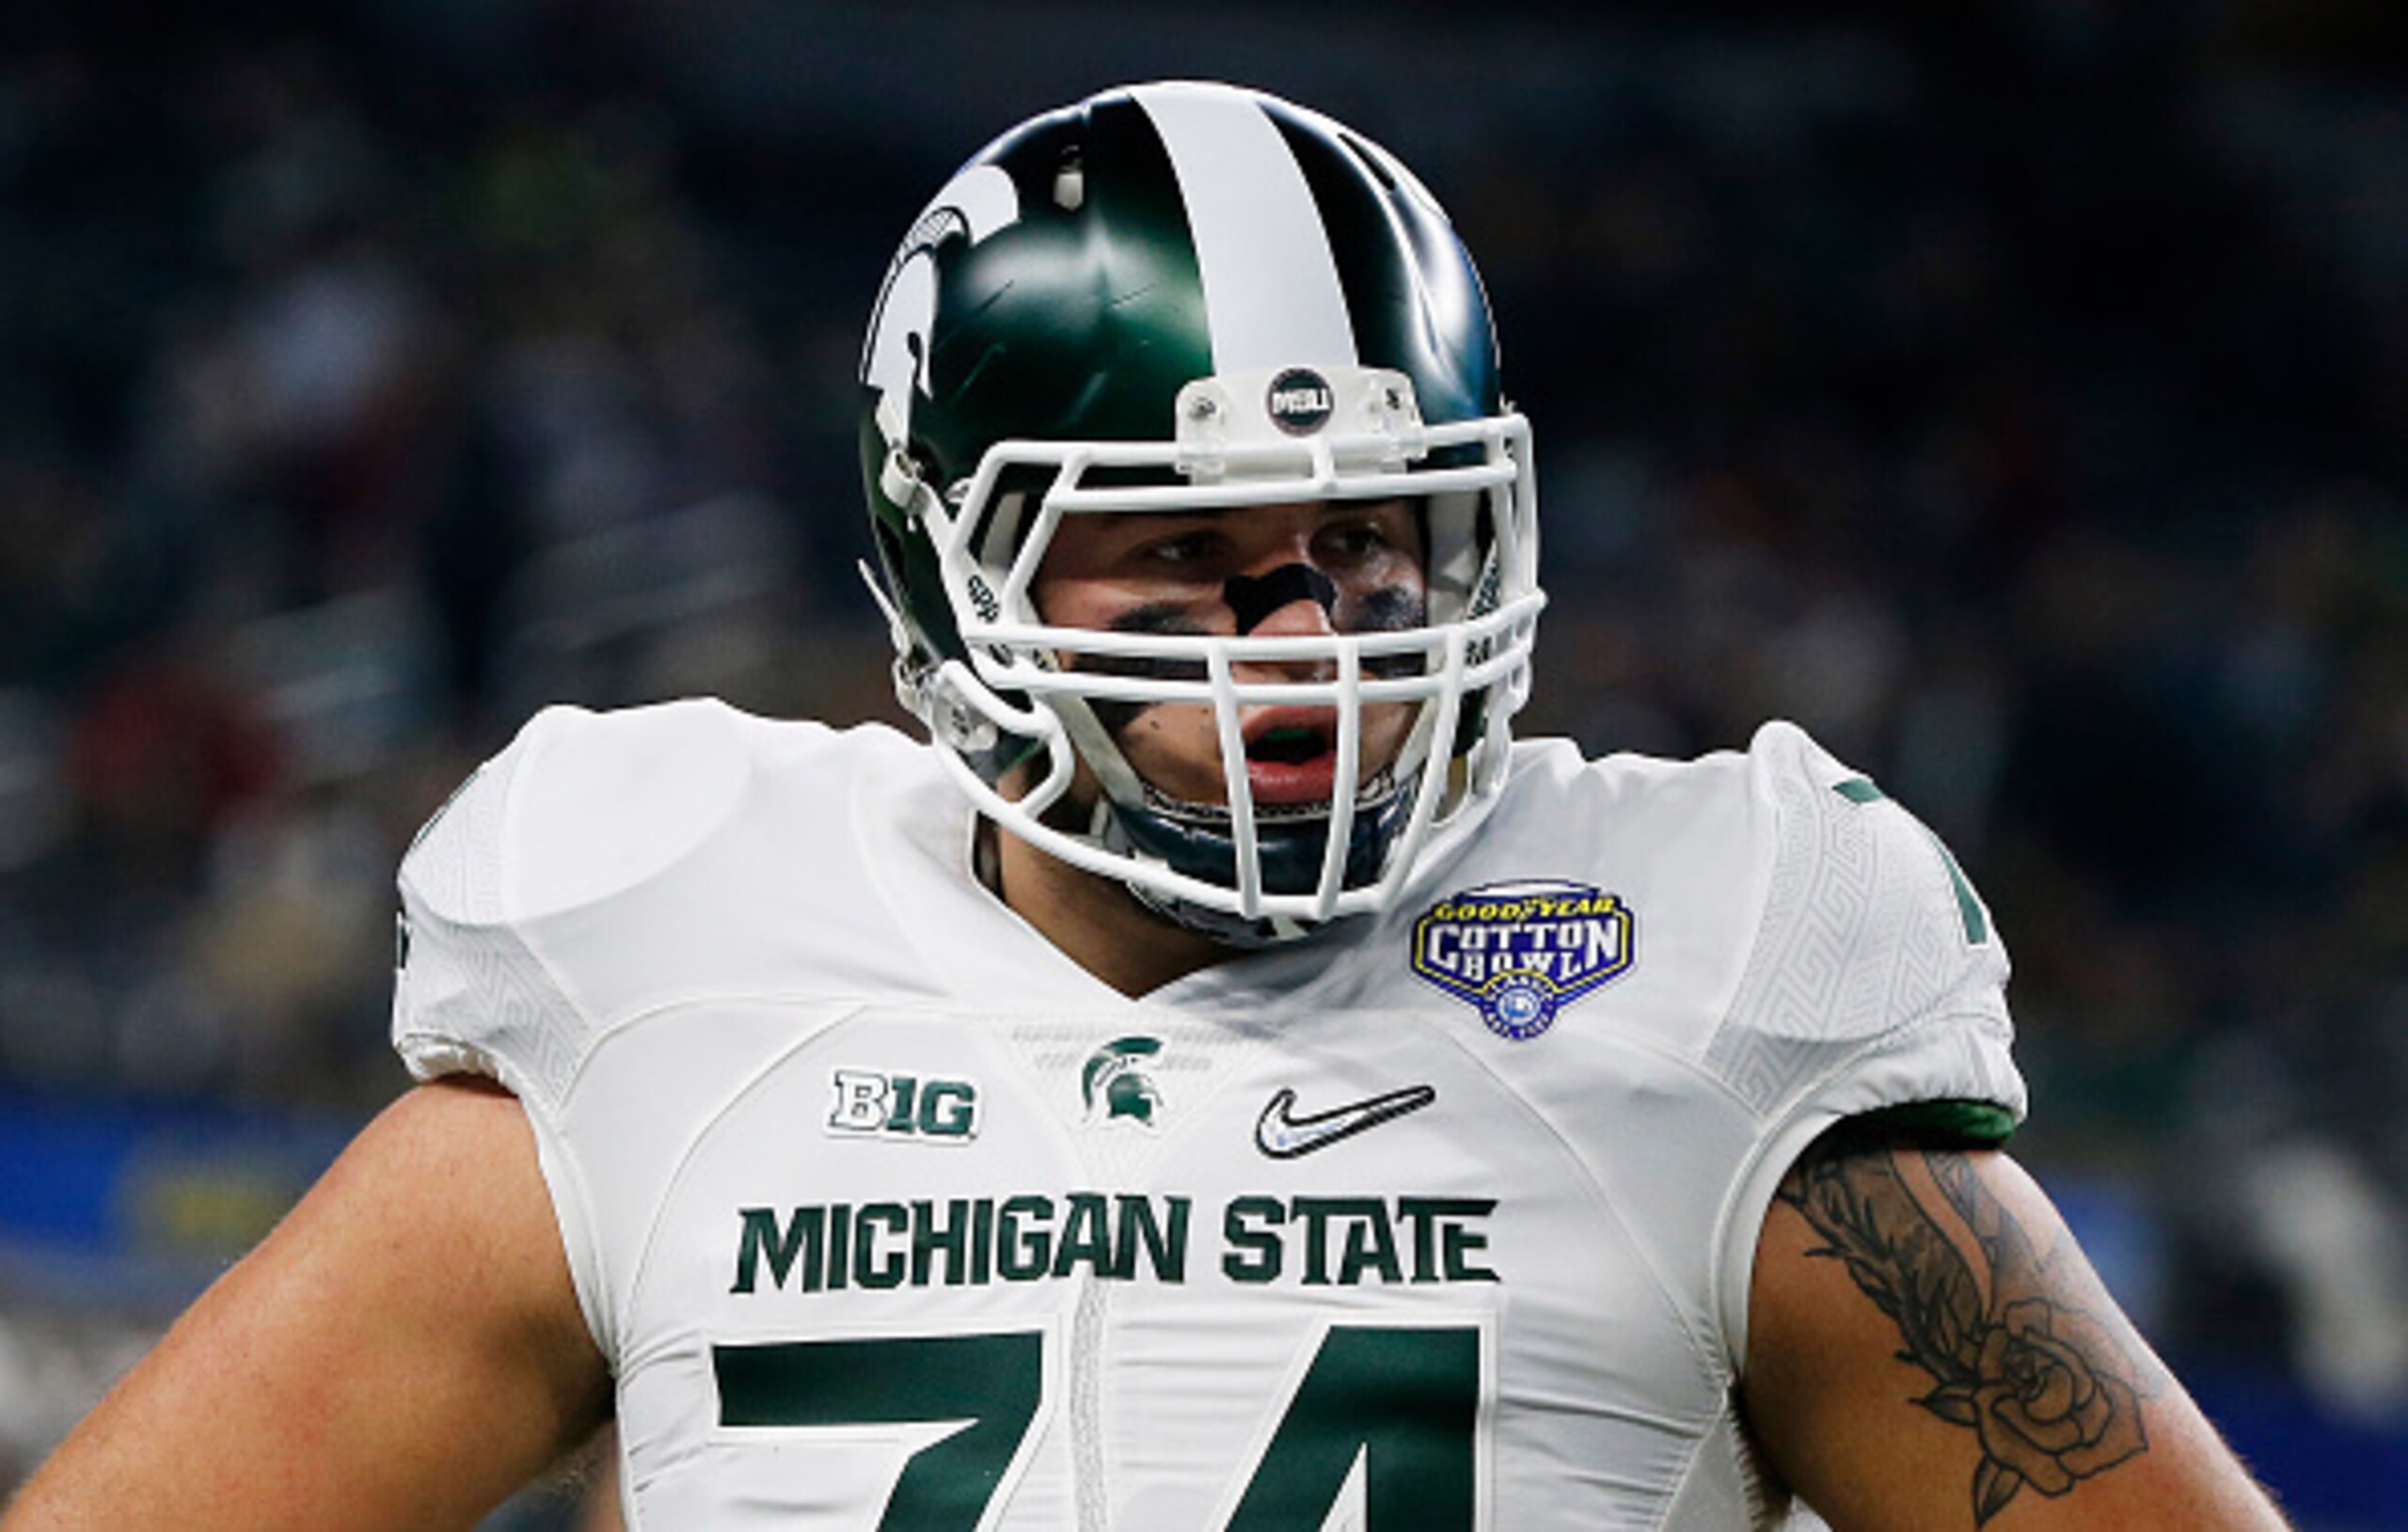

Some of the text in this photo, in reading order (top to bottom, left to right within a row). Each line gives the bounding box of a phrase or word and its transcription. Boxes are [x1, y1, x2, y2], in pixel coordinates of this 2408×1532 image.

[1432, 896, 1616, 923] GOODYEAR
[1427, 918, 1619, 971] COTTON
[1462, 951, 1583, 982] BOWL
[729, 1192, 1502, 1294] MICHIGAN STATE
